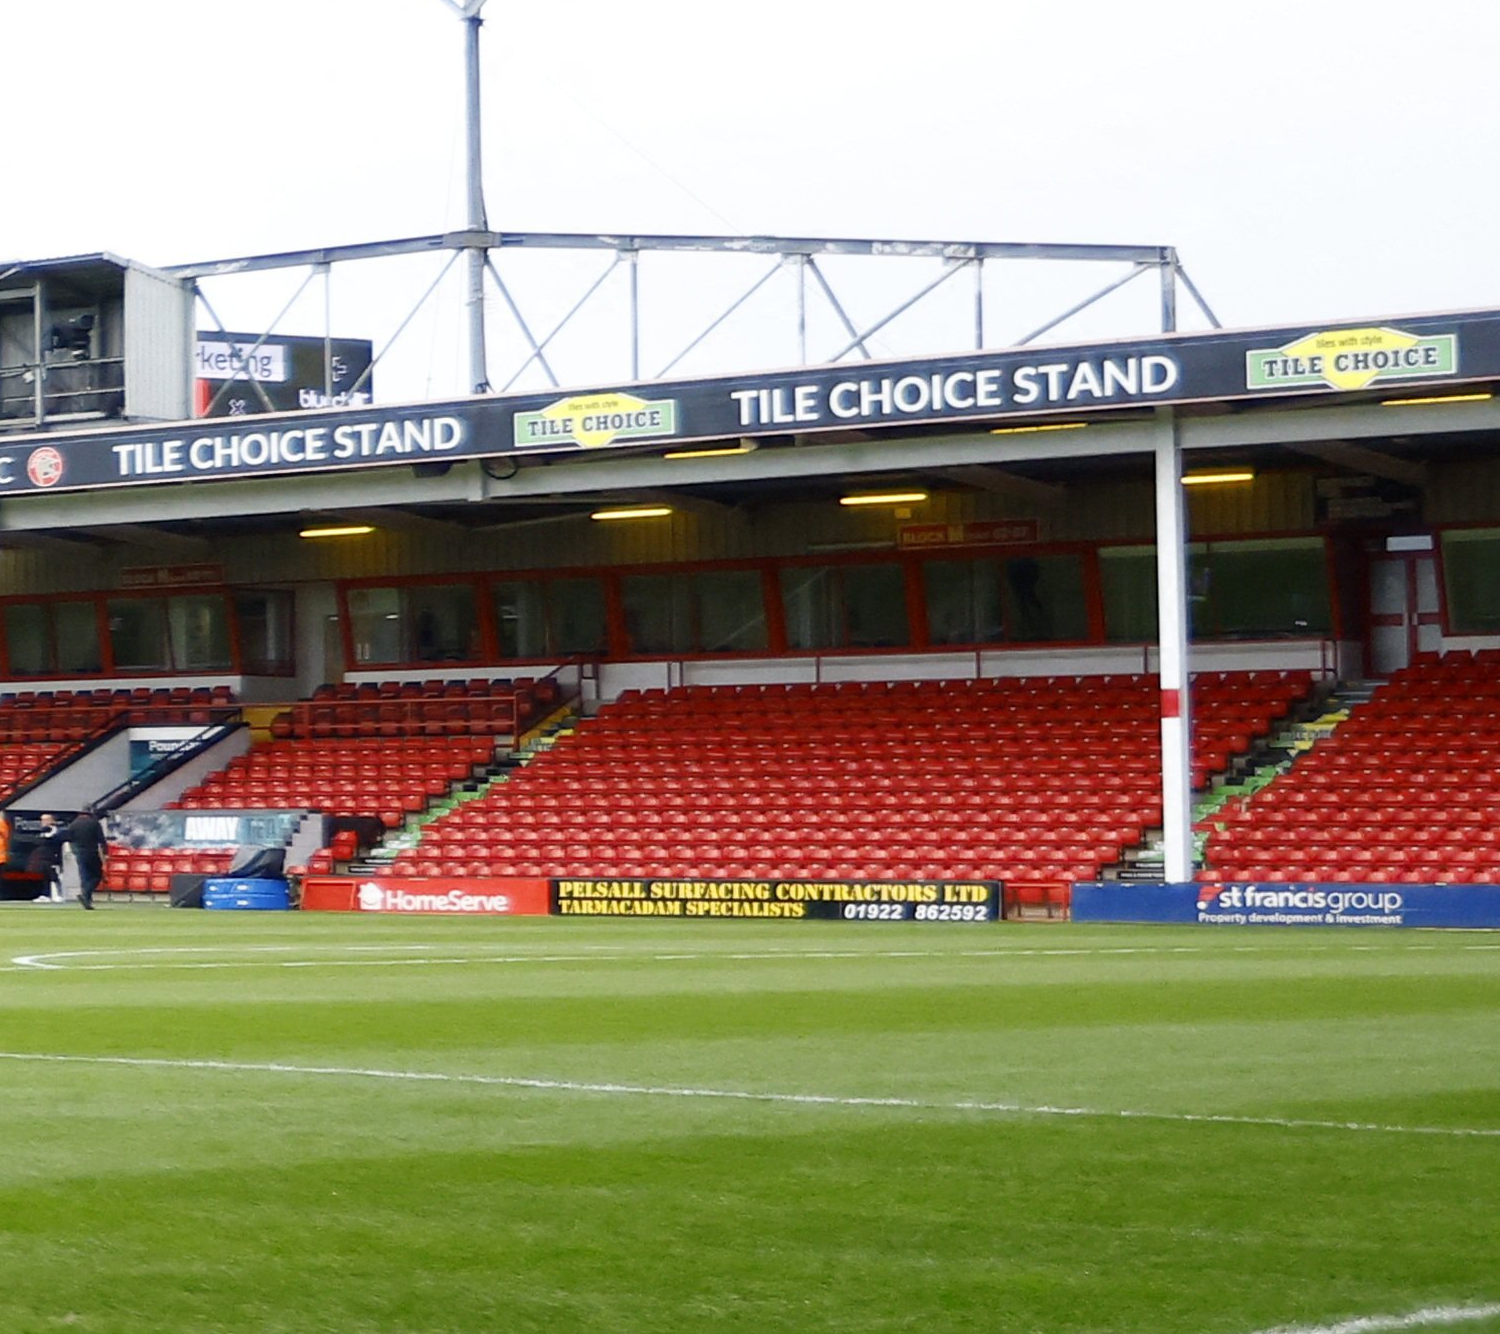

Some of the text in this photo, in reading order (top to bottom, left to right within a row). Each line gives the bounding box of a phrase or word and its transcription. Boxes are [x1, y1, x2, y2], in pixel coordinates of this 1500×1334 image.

[1264, 347, 1438, 378] TILE CHOICE
[730, 355, 1177, 426] TILE CHOICE STAND
[527, 410, 660, 437] TILE CHOICE
[112, 417, 462, 476] TILE CHOICE STAND
[184, 816, 240, 841] AWAY
[386, 889, 509, 911] HomeServe
[558, 881, 988, 902] PELSALL SURFACING CONTRACTORS LTD
[558, 900, 988, 920] TARMACADAM SPECIALISTS 01922 862592
[1198, 912, 1402, 925] Property development & investment
